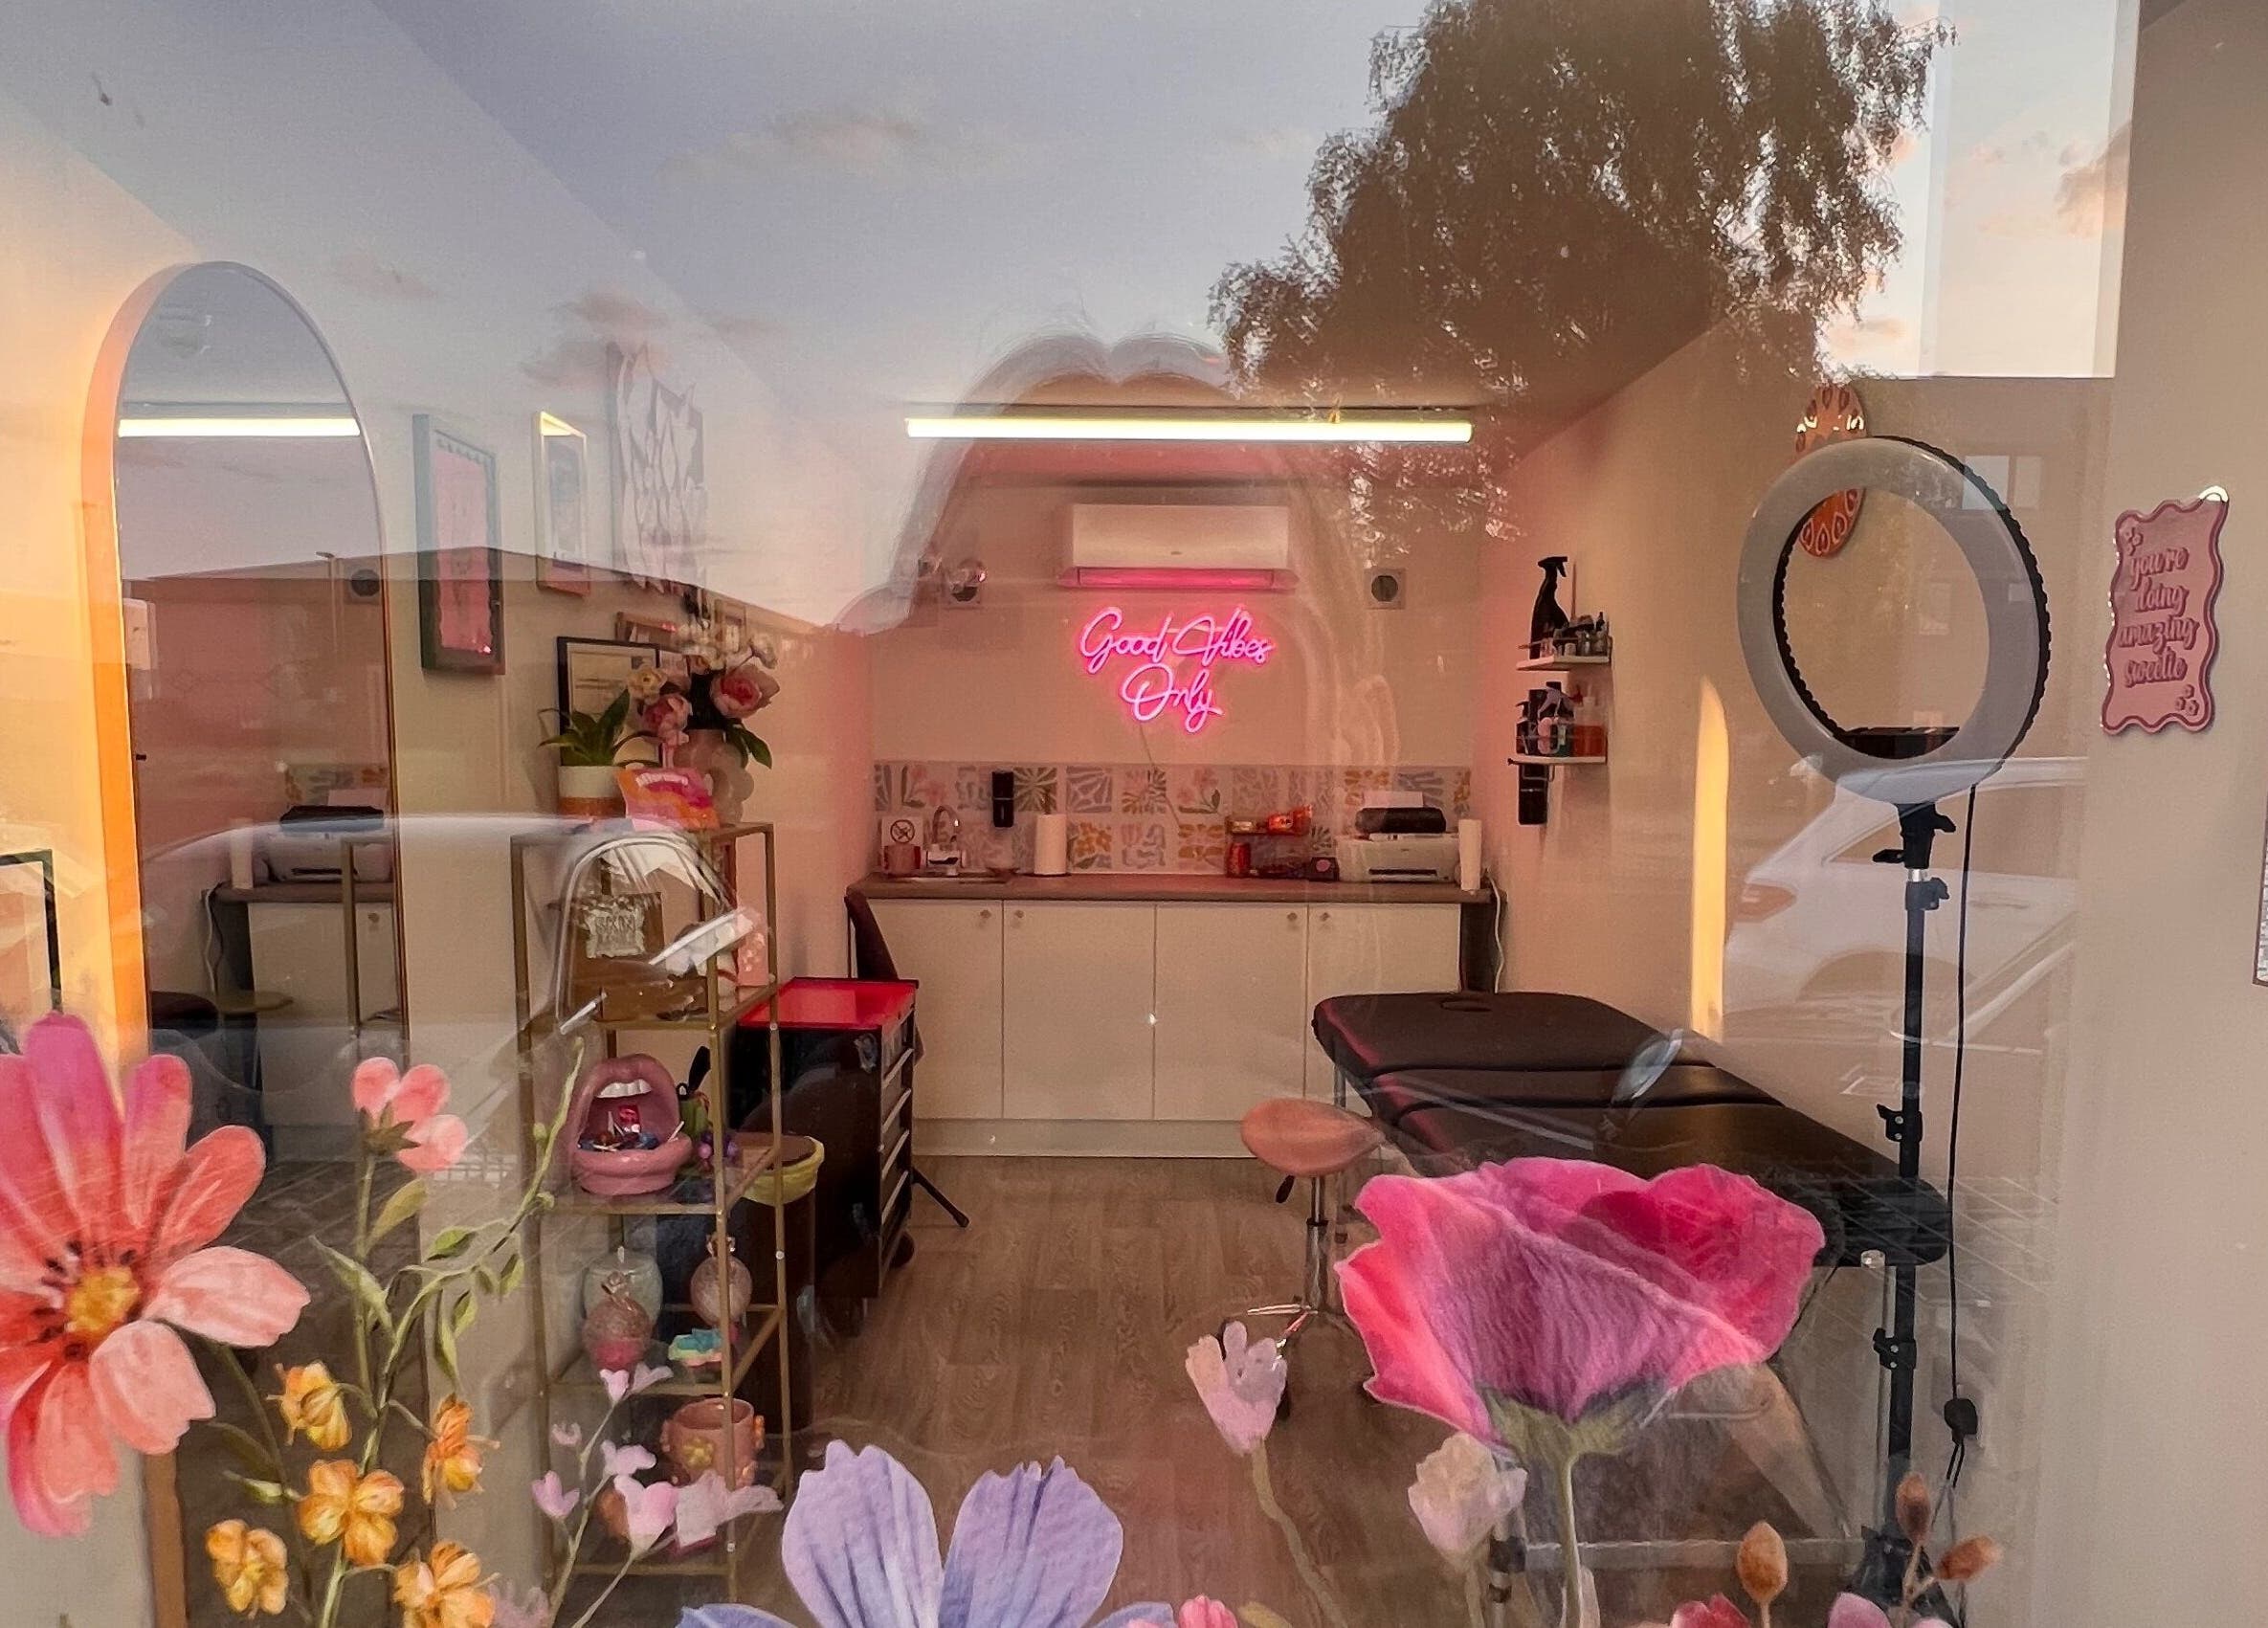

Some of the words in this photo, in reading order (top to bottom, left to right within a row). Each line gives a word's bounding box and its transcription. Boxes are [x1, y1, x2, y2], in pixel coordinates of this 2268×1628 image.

[2135, 576, 2190, 617] doing
[1081, 606, 1171, 674] Good
[1172, 606, 1273, 666] Vibes
[2119, 615, 2200, 655] amazing
[2125, 646, 2189, 687] sweetie
[1122, 663, 1224, 733] Only
